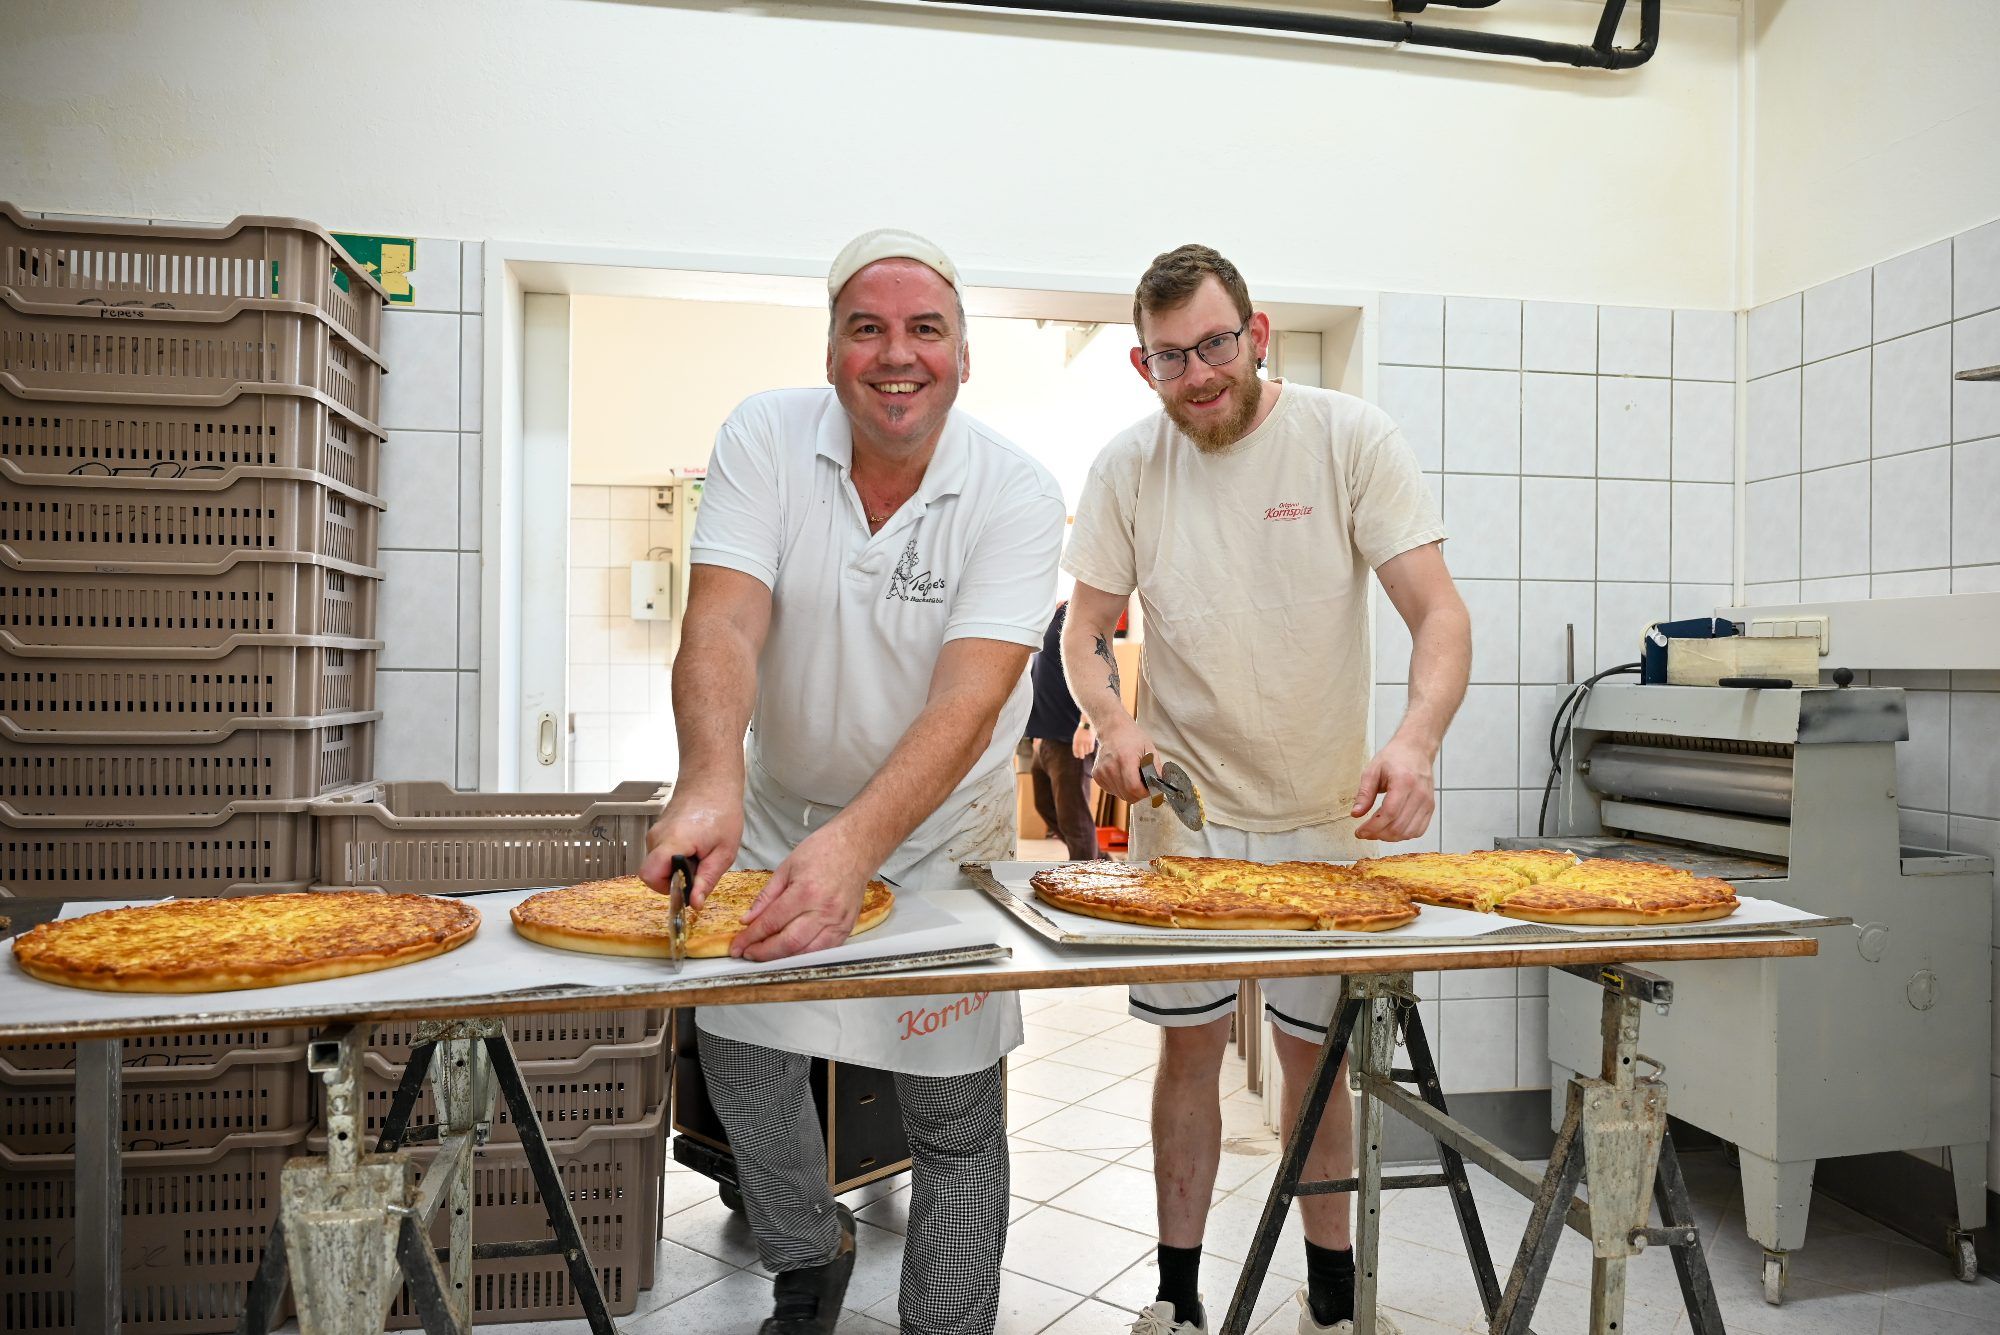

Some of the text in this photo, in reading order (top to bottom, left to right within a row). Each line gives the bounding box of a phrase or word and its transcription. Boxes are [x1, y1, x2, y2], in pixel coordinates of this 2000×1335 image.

[1264, 506, 1313, 520] Kornspitz
[909, 570, 945, 596] Pepe's
[897, 991, 990, 1041] Korns
